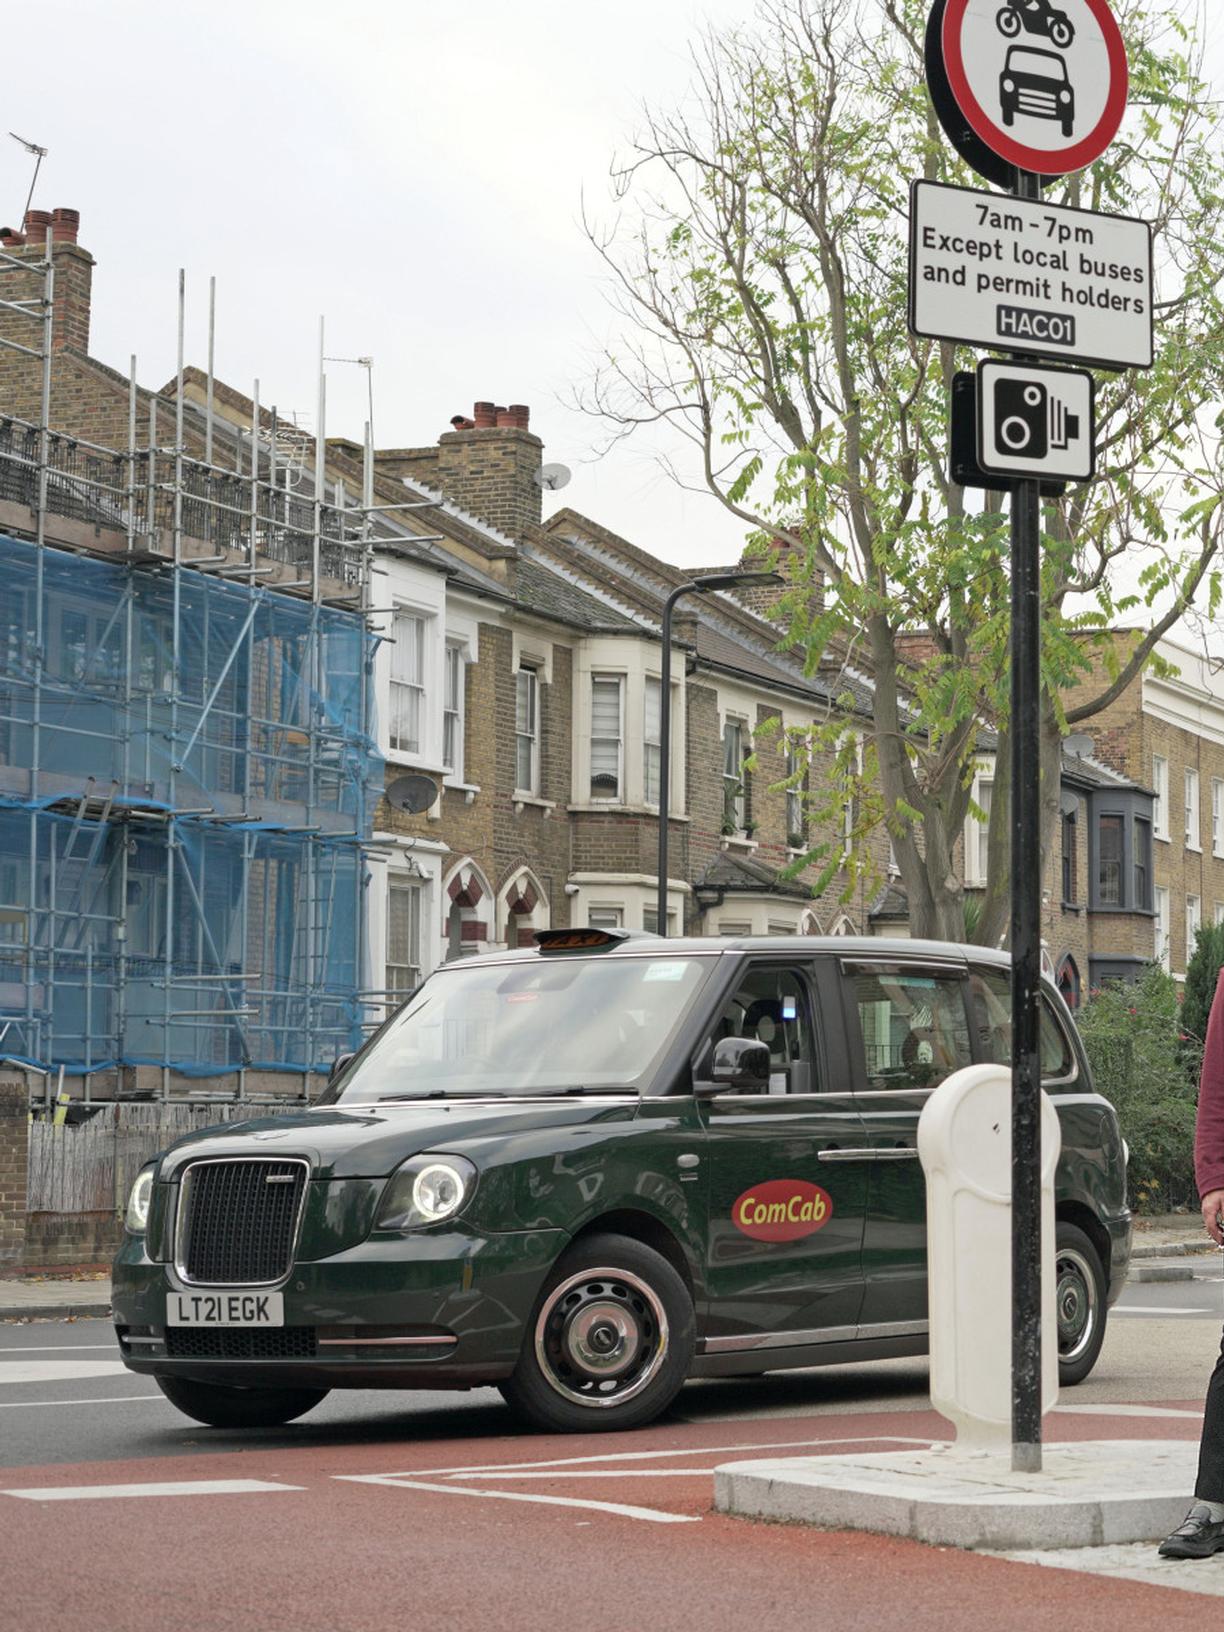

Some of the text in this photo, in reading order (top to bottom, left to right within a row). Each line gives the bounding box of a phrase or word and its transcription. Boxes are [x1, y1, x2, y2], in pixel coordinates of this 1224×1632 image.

[922, 226, 1145, 284] Except local buses
[923, 264, 1145, 314] and permit holders
[740, 1193, 826, 1225] ComCab
[178, 1296, 270, 1322] LT21 EGK
